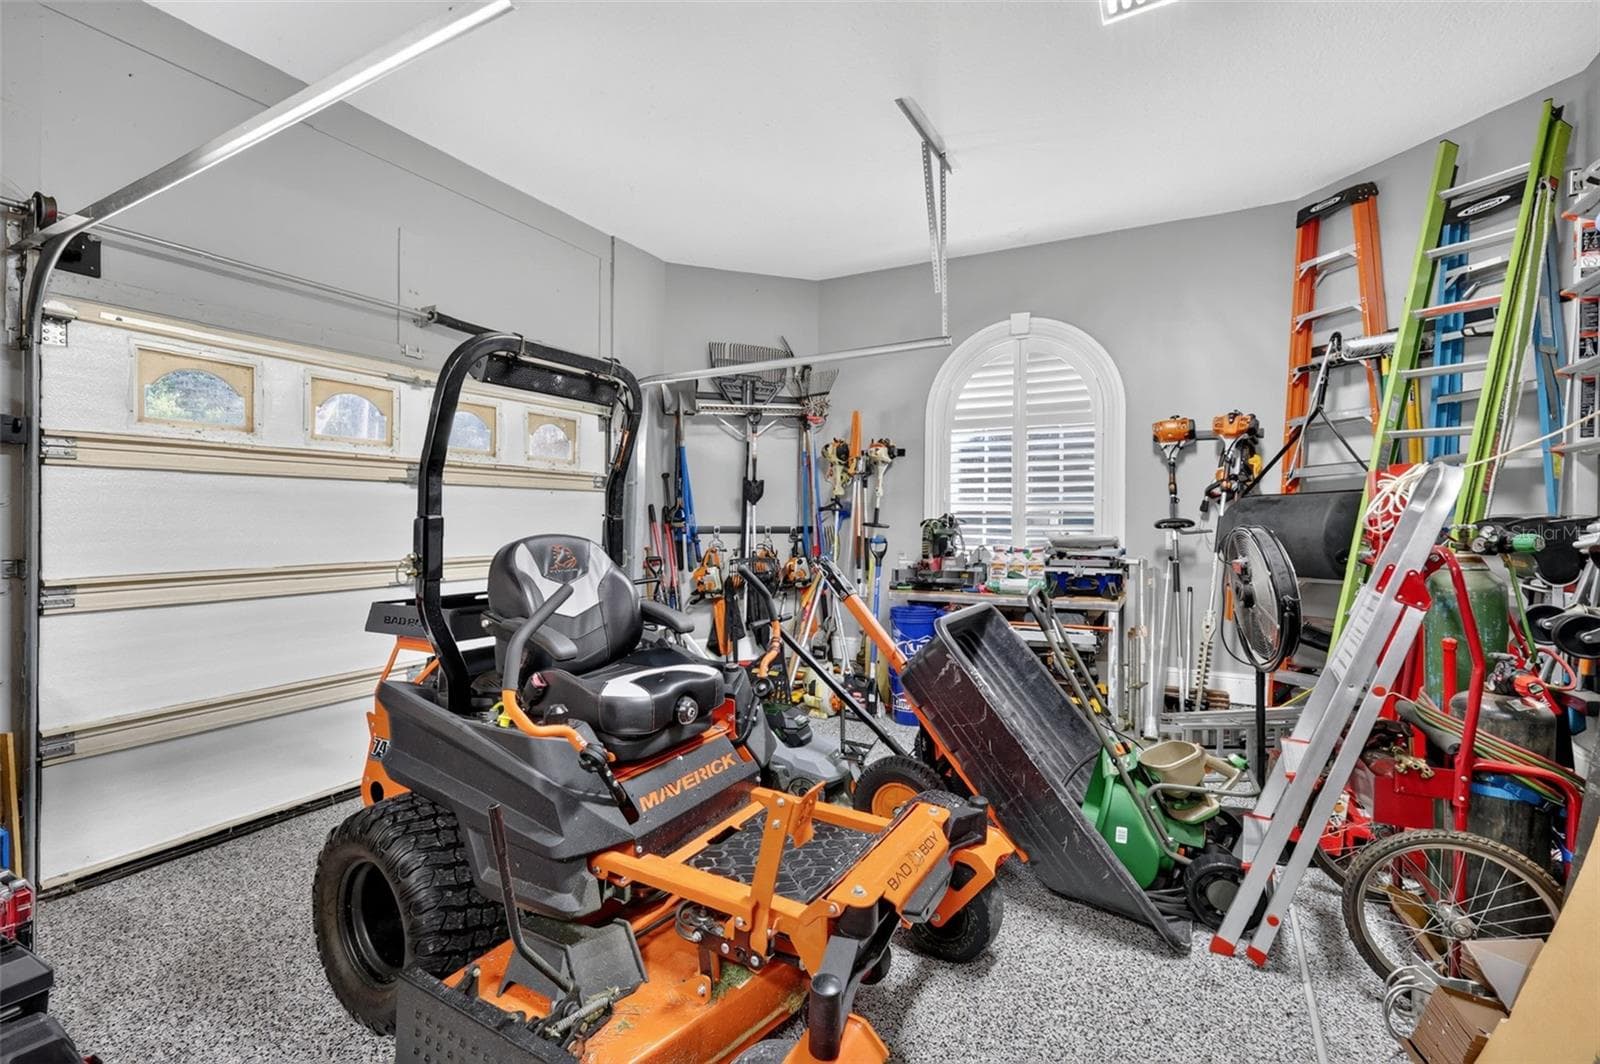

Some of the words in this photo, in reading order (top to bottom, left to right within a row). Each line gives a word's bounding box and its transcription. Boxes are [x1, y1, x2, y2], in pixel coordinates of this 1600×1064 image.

[639, 752, 737, 813] MAVERICK
[886, 862, 913, 891] BAD
[918, 831, 939, 856] BOY
